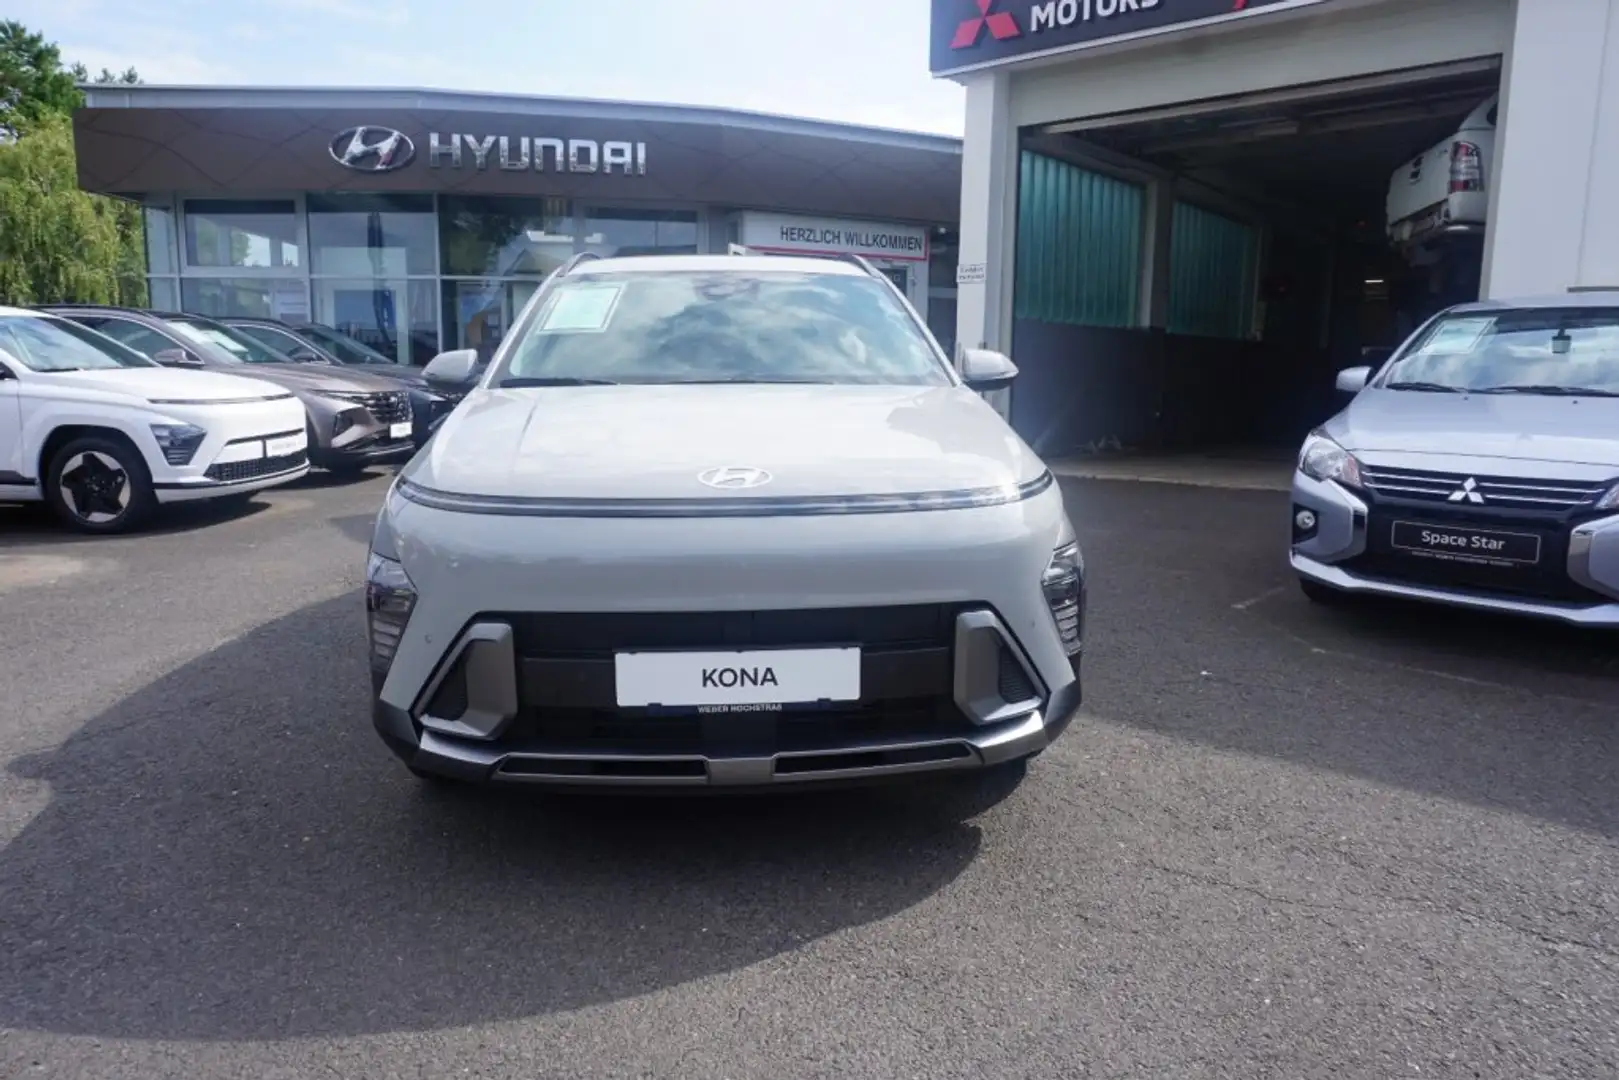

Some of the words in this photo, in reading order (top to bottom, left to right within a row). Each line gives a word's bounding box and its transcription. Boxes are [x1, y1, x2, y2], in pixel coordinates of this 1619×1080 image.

[1030, 0, 1158, 32] MOTO
[428, 132, 647, 176] HYUNDAI
[780, 225, 841, 245] HERZLICH
[844, 231, 922, 251] WILLKOMMEN
[1421, 530, 1467, 547] Space
[1470, 536, 1506, 550] Star
[702, 667, 779, 688] KONA
